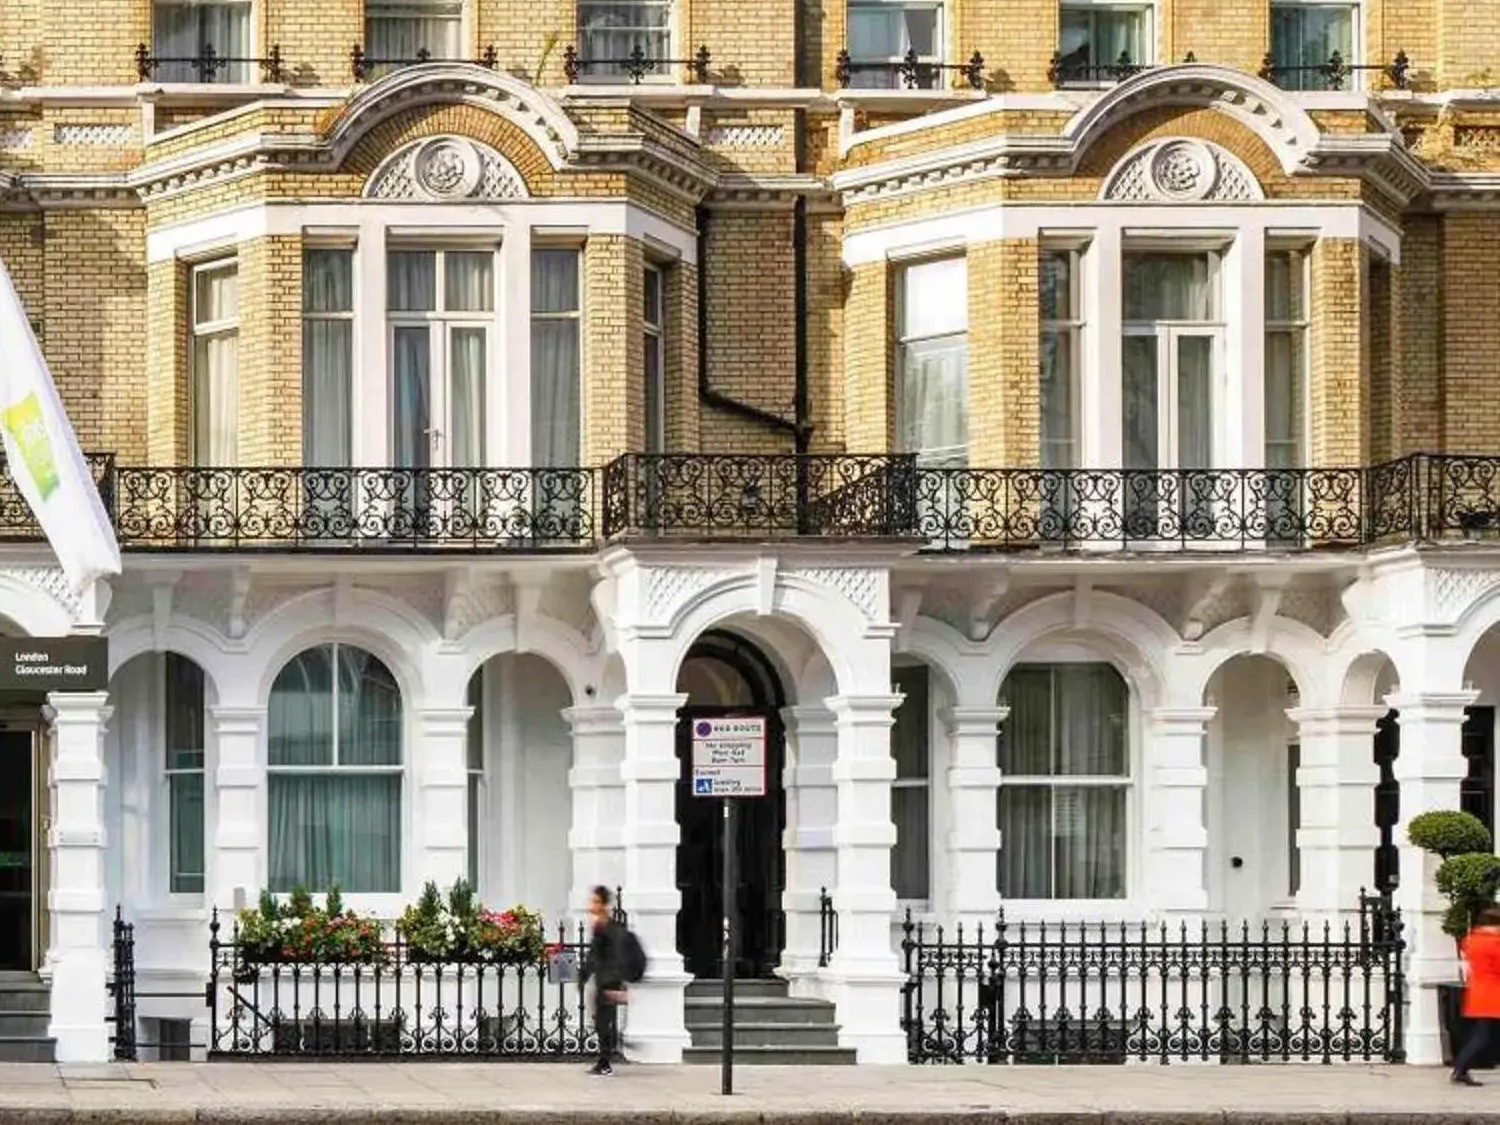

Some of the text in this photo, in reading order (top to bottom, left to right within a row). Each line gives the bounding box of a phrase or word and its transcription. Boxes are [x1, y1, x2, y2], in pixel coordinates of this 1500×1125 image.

[15, 652, 49, 662] London
[15, 663, 88, 675] Gloucester Road
